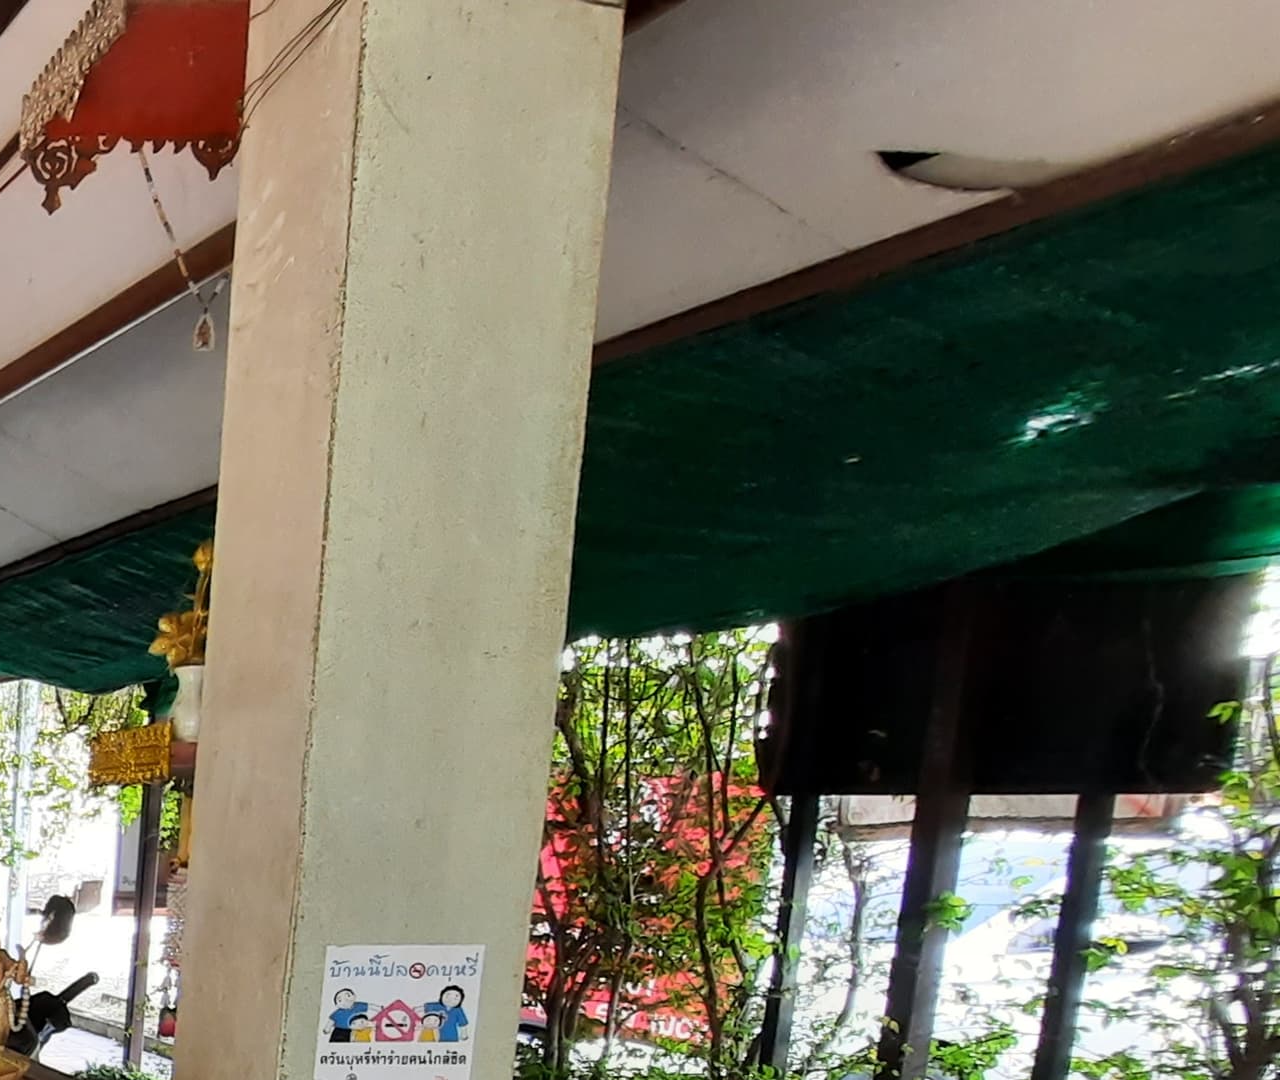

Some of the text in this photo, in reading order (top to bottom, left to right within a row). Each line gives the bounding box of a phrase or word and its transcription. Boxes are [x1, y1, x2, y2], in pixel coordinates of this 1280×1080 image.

[320, 1047, 467, 1070] ควันบุหรี่ทำร้ายคนใกล้ชิด
